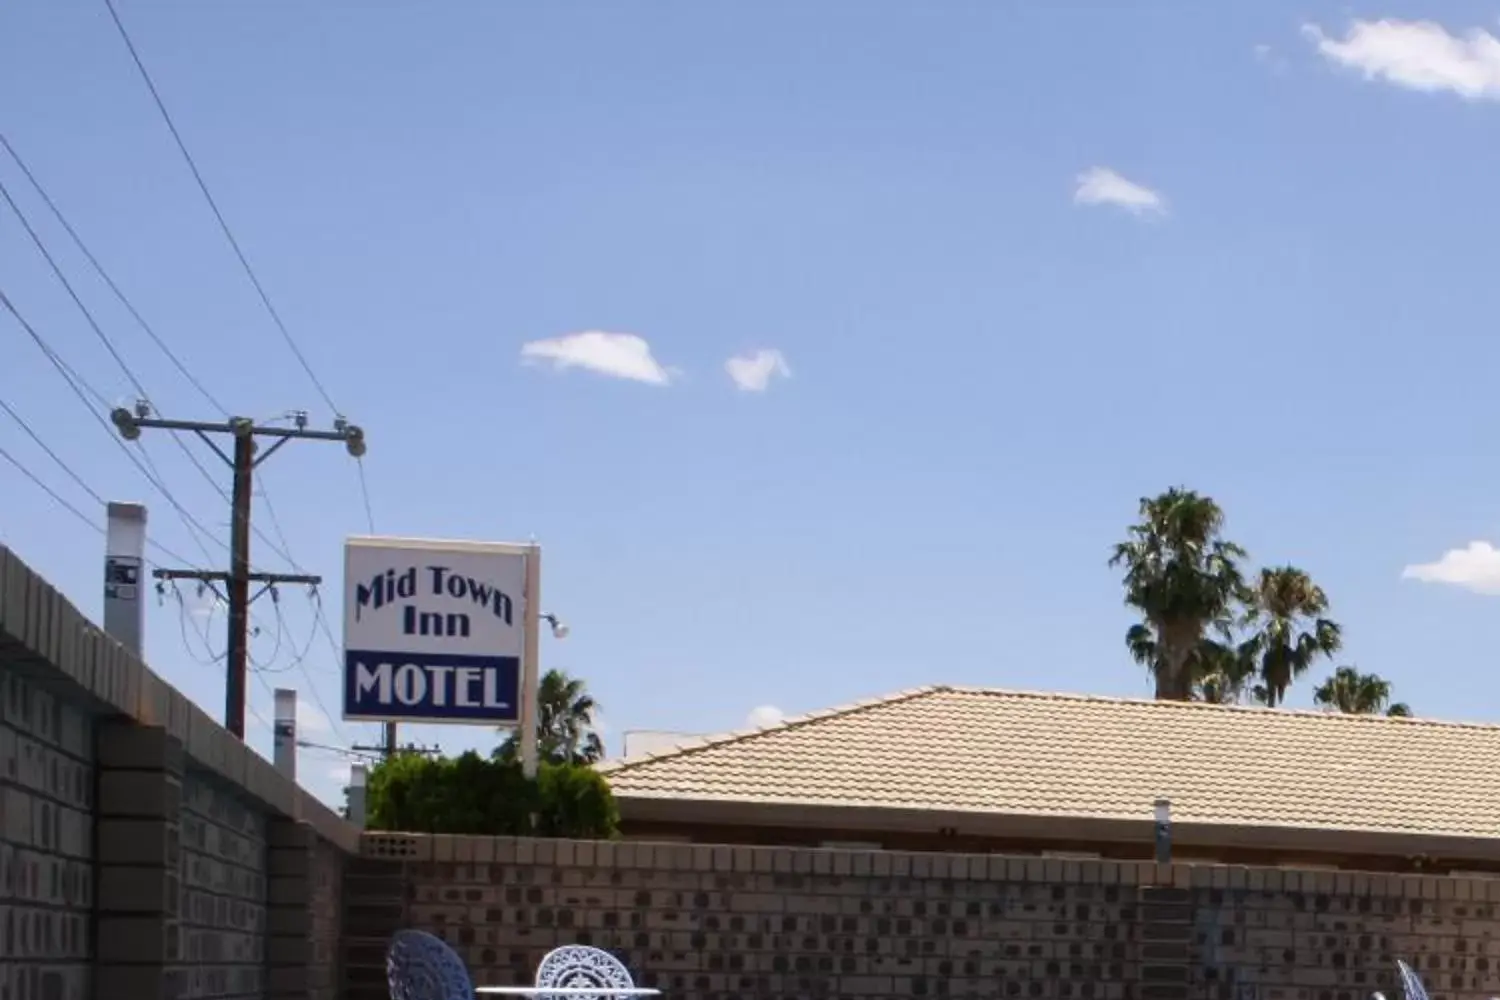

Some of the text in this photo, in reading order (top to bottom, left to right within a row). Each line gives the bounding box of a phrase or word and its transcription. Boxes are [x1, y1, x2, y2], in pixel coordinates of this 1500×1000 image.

[355, 565, 513, 627] Mid Town
[404, 604, 470, 637] Inn
[355, 662, 510, 708] MOTEL
